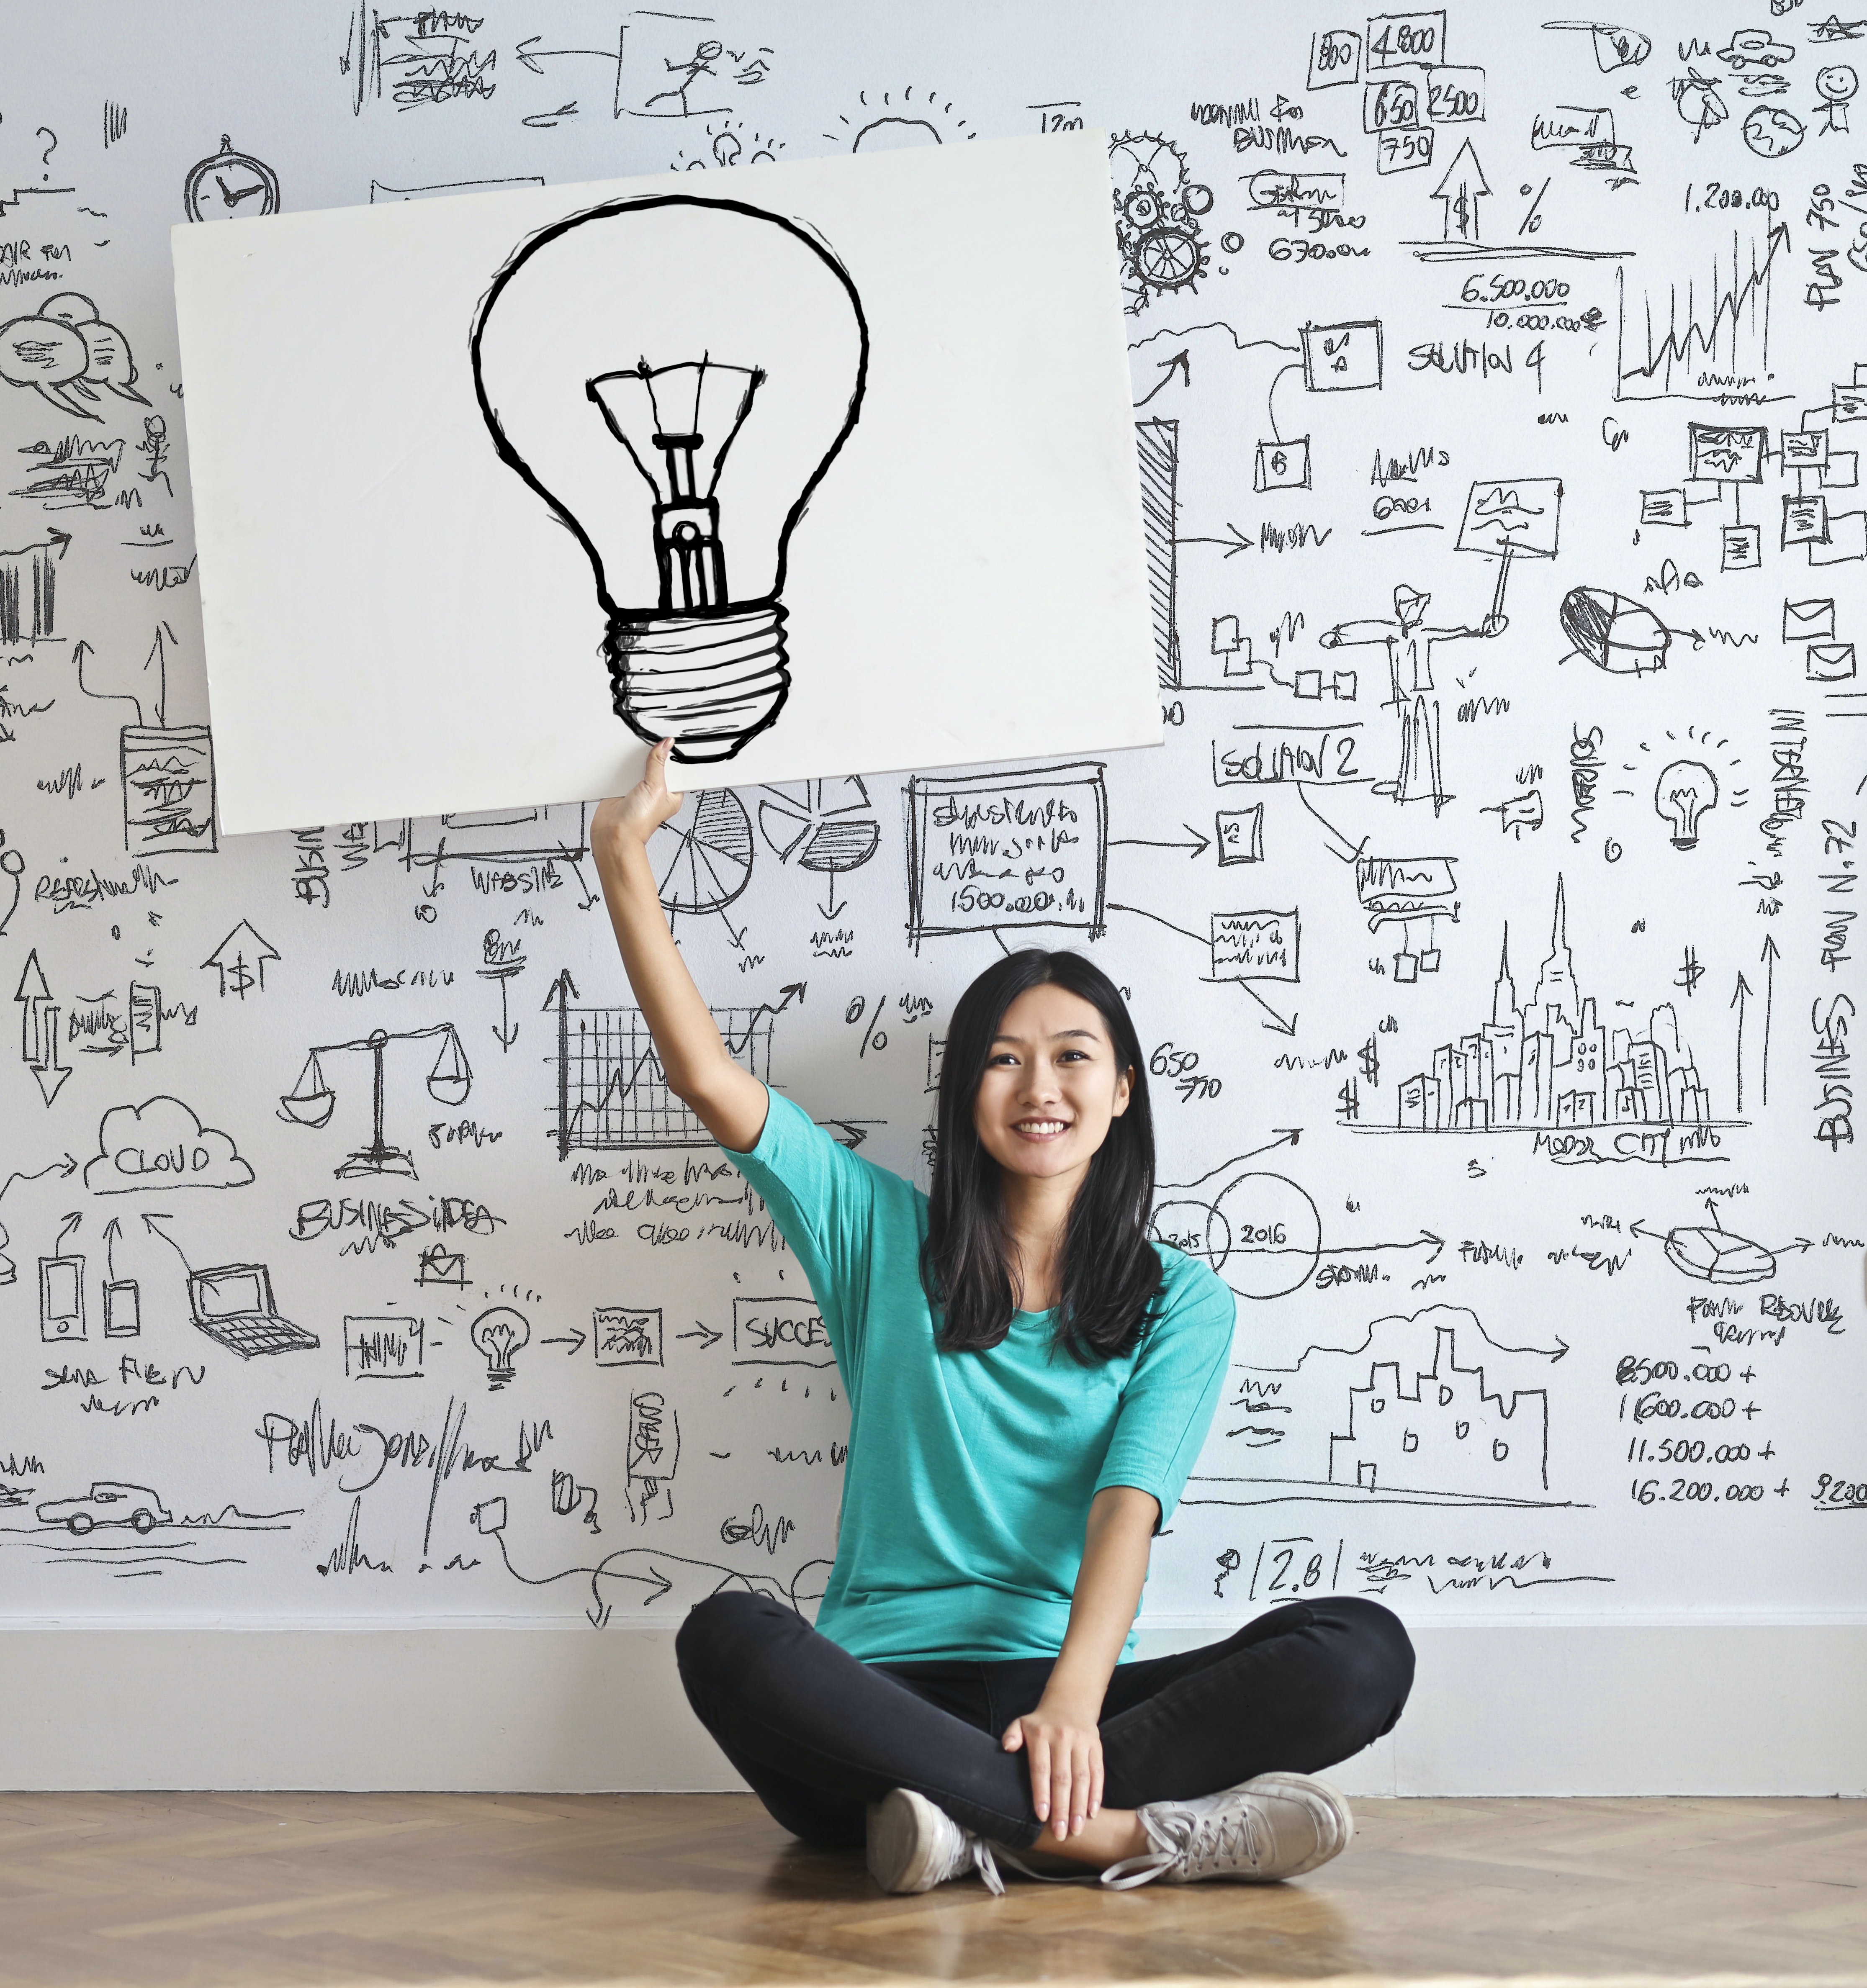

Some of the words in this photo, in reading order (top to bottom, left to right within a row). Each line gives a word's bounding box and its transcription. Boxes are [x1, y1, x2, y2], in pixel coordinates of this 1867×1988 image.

[1384, 135, 1430, 163] 750
[1806, 184, 1840, 231] 750
[1337, 738, 1359, 776] 2
[1150, 1042, 1199, 1077] 650
[115, 1144, 210, 1175] CLOUD
[1240, 1223, 1286, 1246] 2016
[1628, 1436, 1750, 1463] 11.500.000
[1631, 1478, 1764, 1505] 16.200.000
